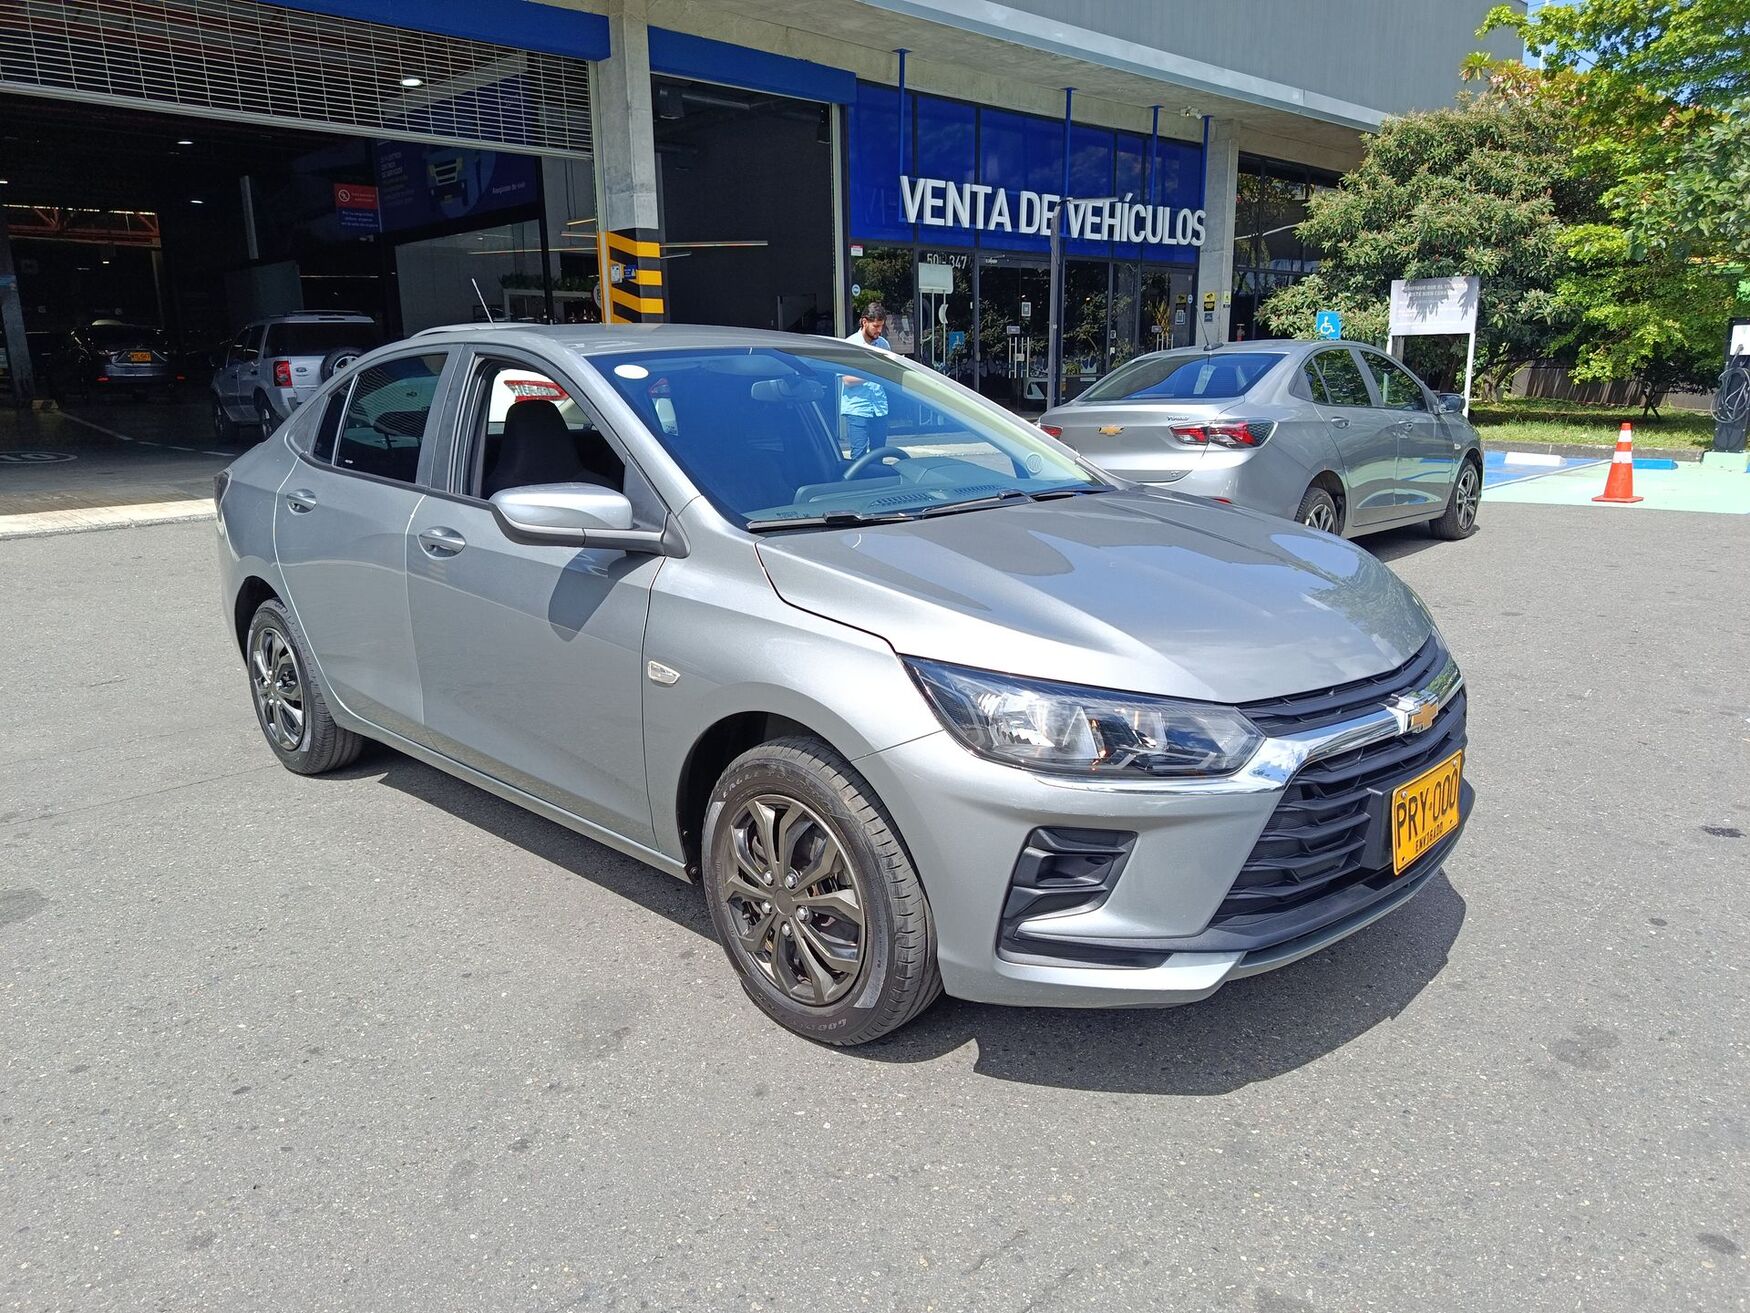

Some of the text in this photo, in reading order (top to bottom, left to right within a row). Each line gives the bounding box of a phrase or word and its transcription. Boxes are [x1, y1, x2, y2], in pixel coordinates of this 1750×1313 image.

[900, 176, 1206, 246] VENTA DE VEHÍCULOS
[949, 254, 967, 269] 347
